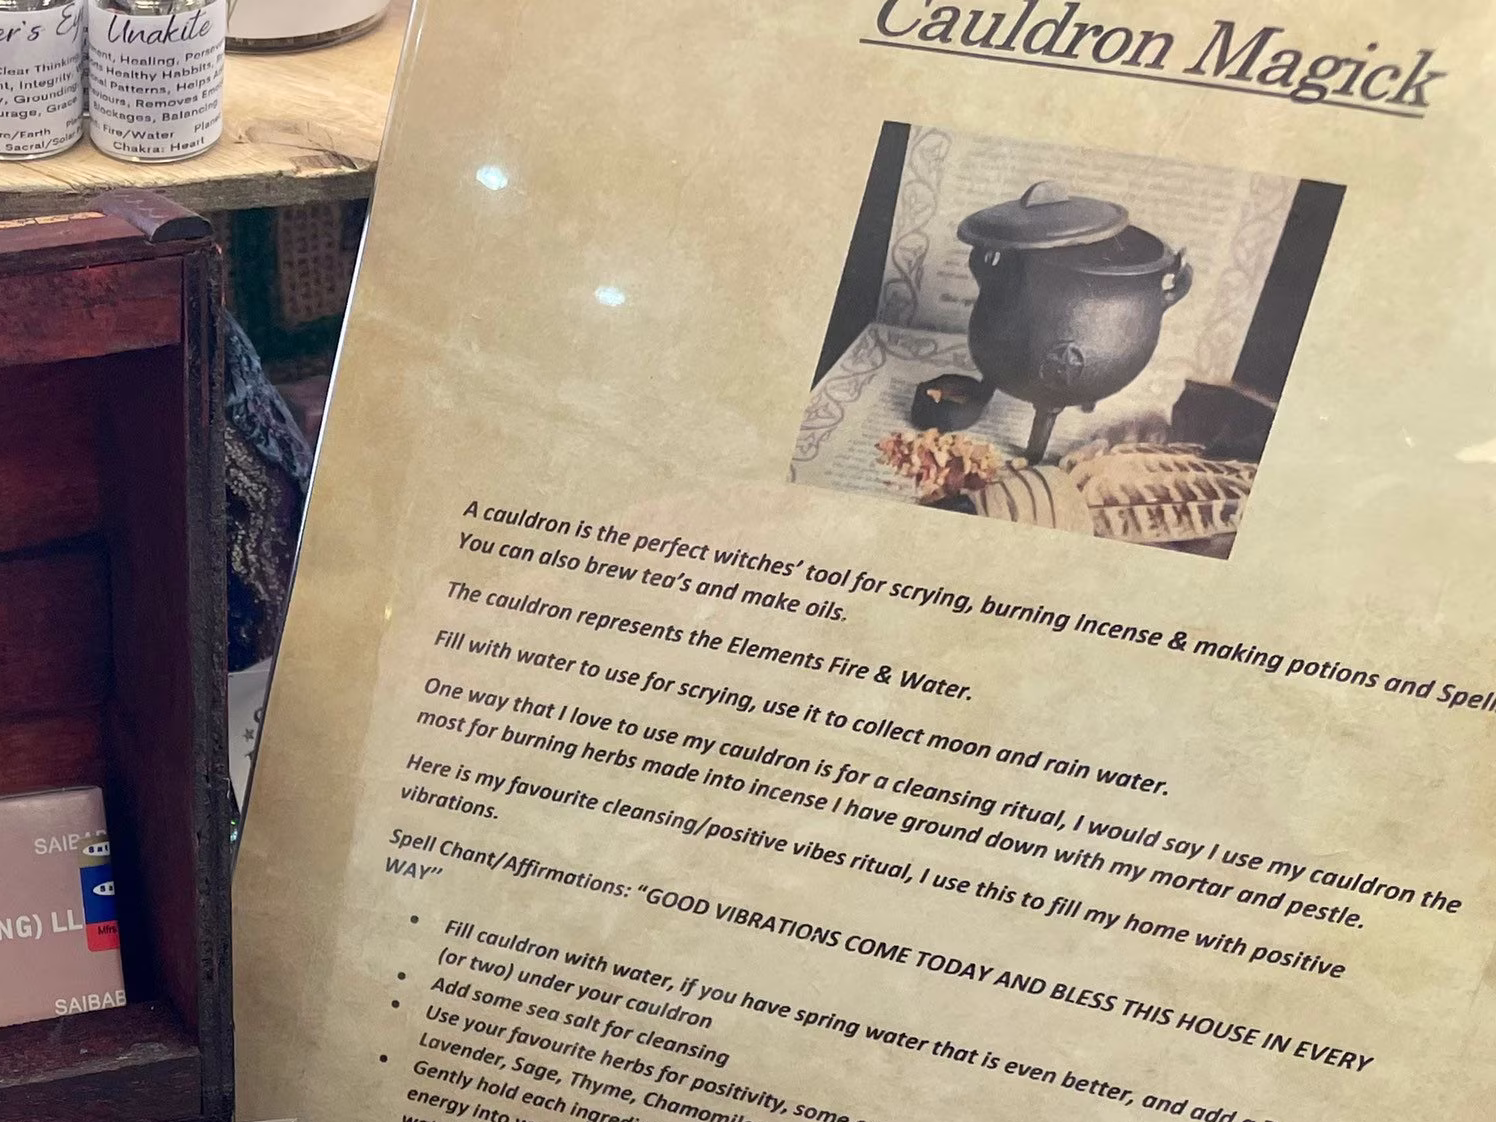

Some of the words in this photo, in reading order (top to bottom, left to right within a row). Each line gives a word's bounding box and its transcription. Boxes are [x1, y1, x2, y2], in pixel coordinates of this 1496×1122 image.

[106, 10, 212, 45] Unakite
[875, 0, 1173, 70] Cauldron
[1183, 20, 1449, 107] Magick
[110, 81, 171, 95] Patterns,
[135, 95, 198, 109] Removes
[462, 500, 478, 518] A
[483, 507, 571, 535] cauldron
[574, 520, 593, 539] is
[597, 525, 631, 546] the
[632, 535, 710, 561] perfect
[714, 549, 805, 577] witches’
[805, 564, 852, 587] tool
[848, 571, 888, 593] for
[888, 583, 973, 614] scrying,
[980, 595, 1071, 632] burning
[1074, 613, 1163, 646] Incense
[1167, 631, 1188, 652] &
[1193, 640, 1284, 673] making
[1284, 658, 1380, 688] potions
[1384, 677, 1437, 699] and
[448, 581, 482, 603] The
[485, 592, 573, 621] cauldron
[576, 610, 684, 642] represents
[688, 629, 723, 650] the
[727, 636, 825, 670] Elements
[828, 656, 870, 679] Fire
[873, 665, 892, 685] &
[900, 670, 972, 701] Water.
[52, 910, 83, 934] LL
[389, 828, 437, 852] Spell
[439, 840, 632, 898] Chant/Affirmations:
[716, 903, 842, 947] VIBRATIONS
[844, 935, 913, 964] COME
[915, 951, 995, 982] TODAY
[992, 971, 1047, 995] AND
[1049, 983, 1118, 1012] BLESS
[1122, 999, 1175, 1025] THIS
[1175, 1013, 1261, 1046] HOUSE
[1261, 1033, 1293, 1053] IN
[1293, 1041, 1375, 1072] EVERY
